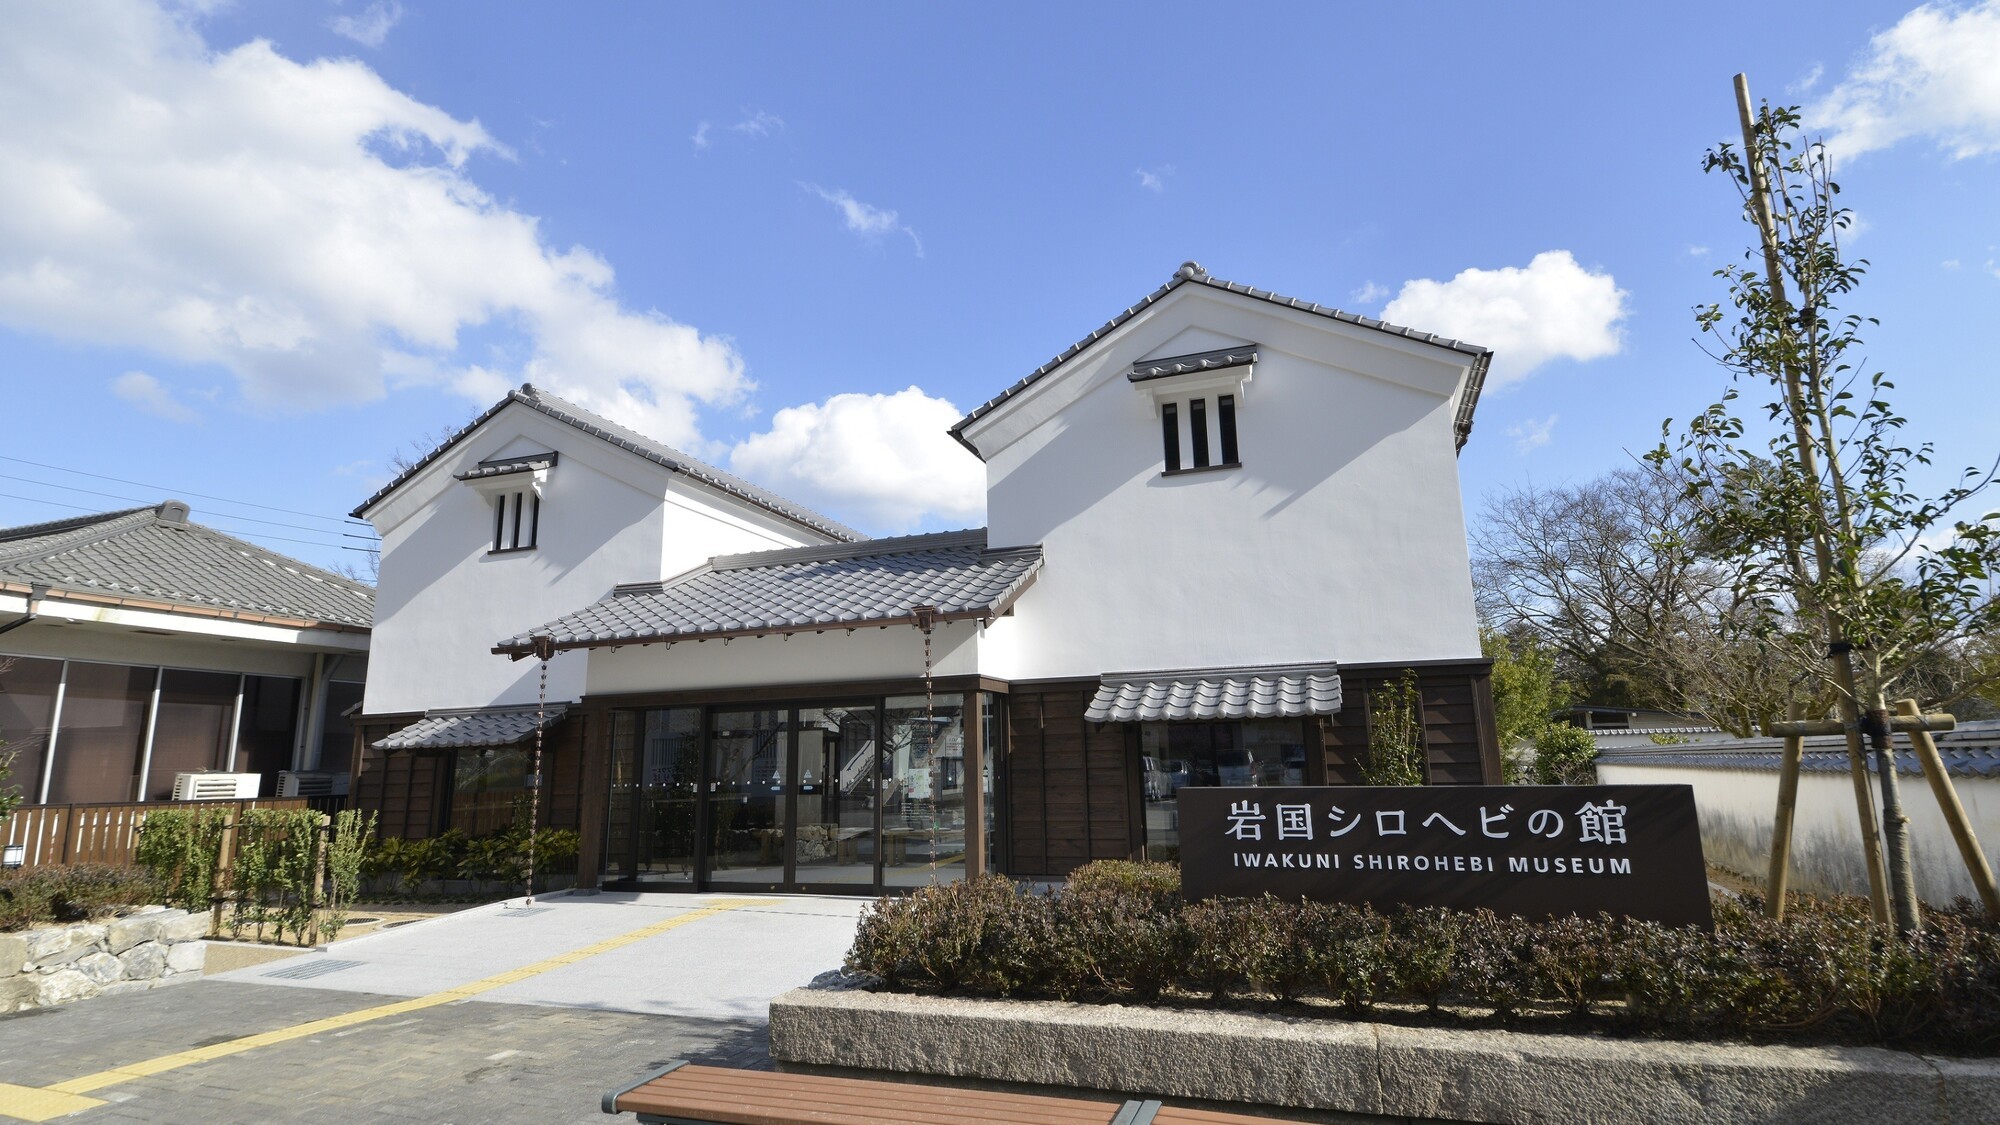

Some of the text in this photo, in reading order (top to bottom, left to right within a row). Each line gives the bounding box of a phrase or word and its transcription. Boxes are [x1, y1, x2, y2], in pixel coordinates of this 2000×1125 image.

[1224, 799, 1628, 845] 岩国シロヘビの館
[1233, 852, 1632, 875] IWAKUNI SHIROHEBI MUSEUM
